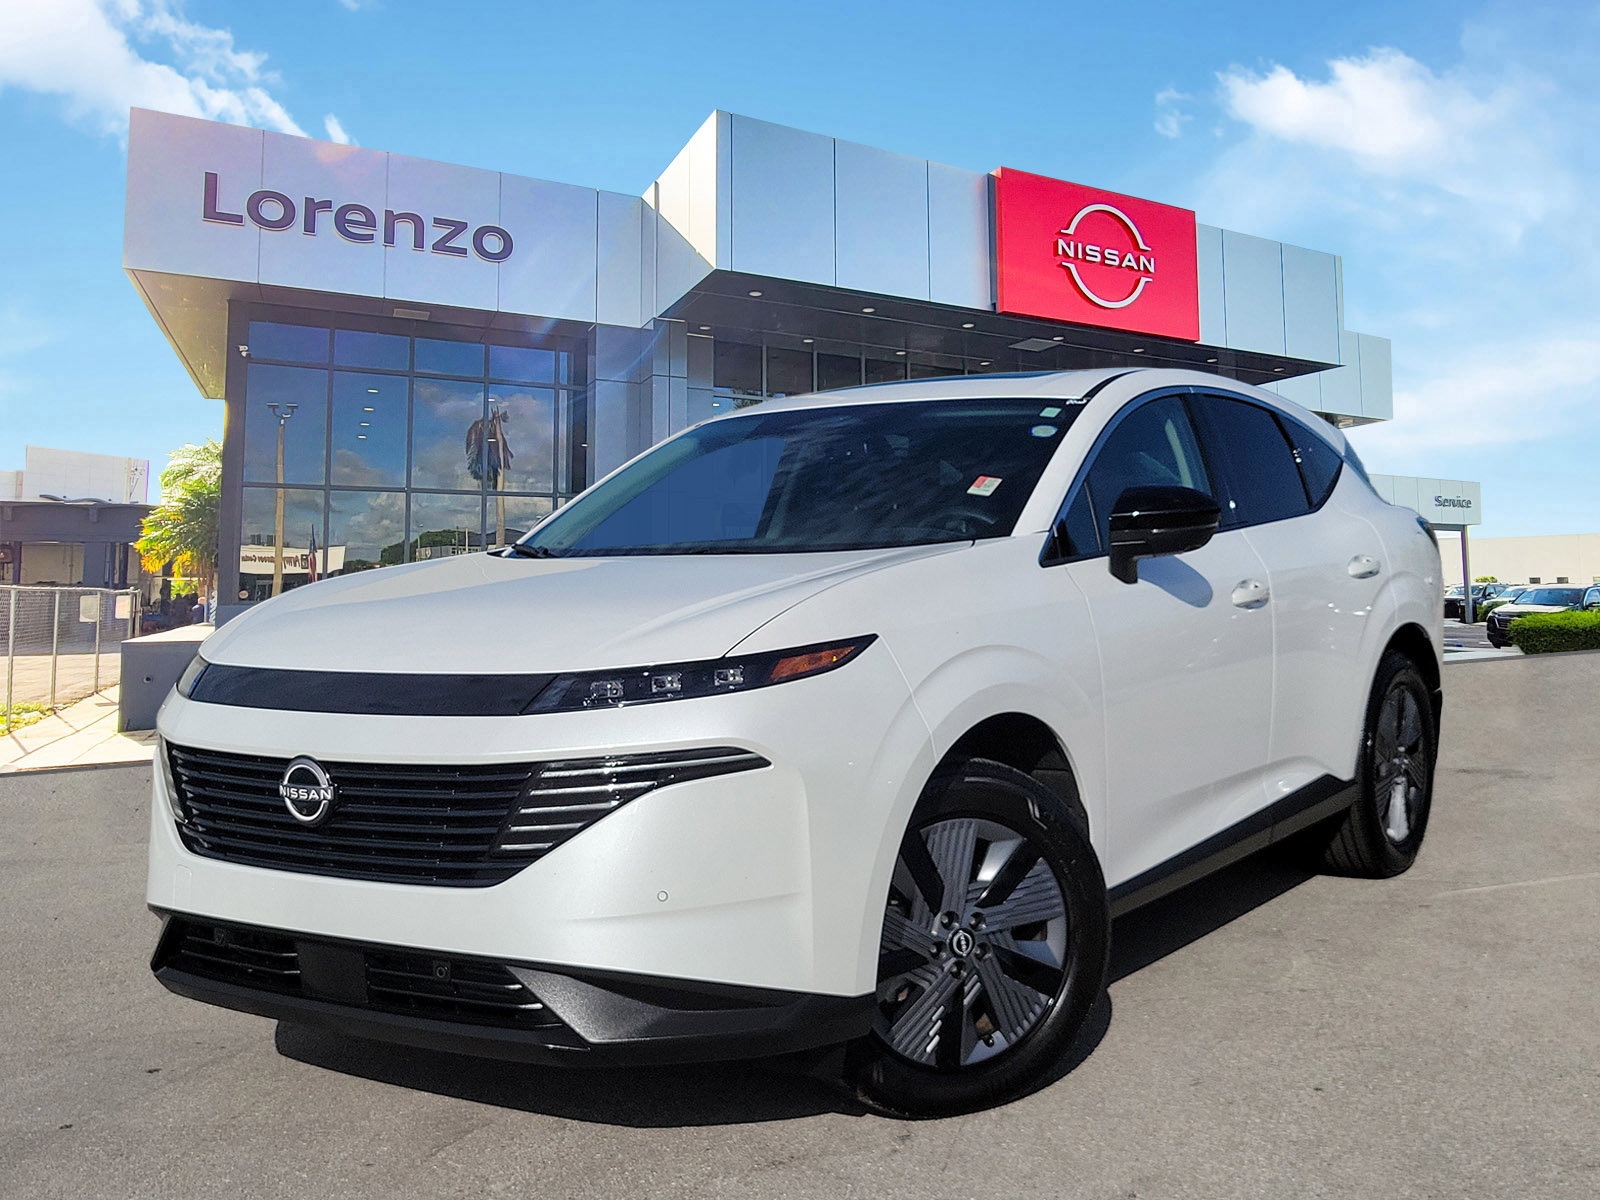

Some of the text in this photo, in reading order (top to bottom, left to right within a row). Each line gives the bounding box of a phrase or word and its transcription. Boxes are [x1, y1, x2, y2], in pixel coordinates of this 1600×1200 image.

[202, 171, 514, 262] Lorenzo
[1057, 238, 1155, 273] NISSAN
[1434, 495, 1472, 509] Service
[279, 784, 332, 801] NISSAN
